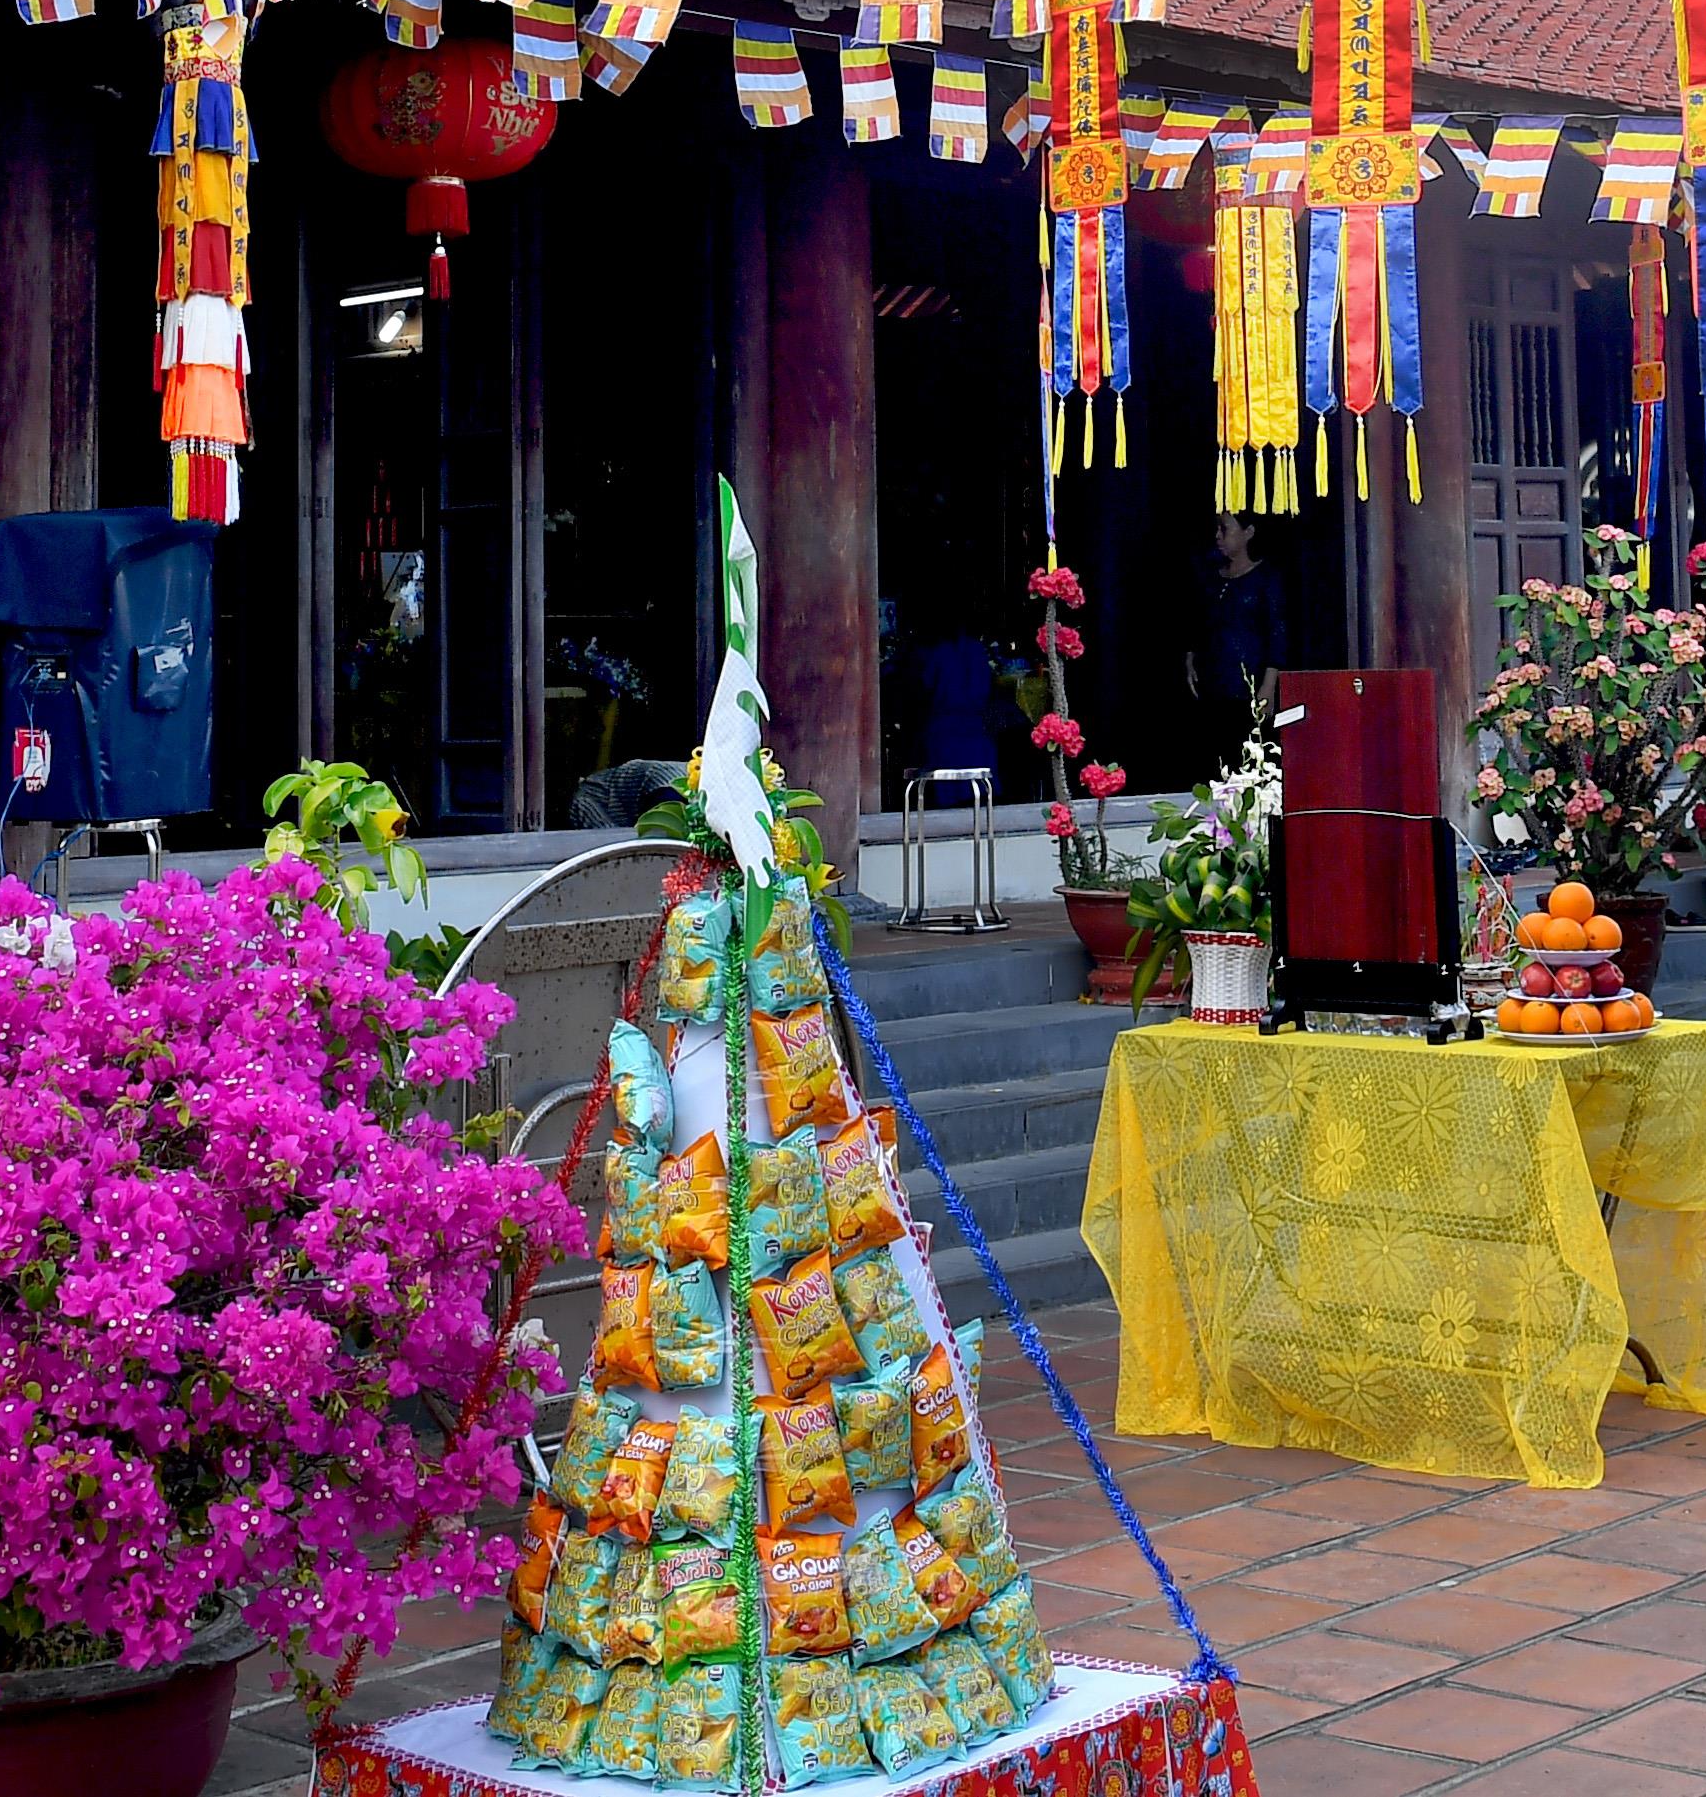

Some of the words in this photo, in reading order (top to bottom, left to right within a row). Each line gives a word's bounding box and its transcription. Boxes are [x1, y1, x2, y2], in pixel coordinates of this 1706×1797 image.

[1352, 961, 1364, 973] 1
[761, 1268, 830, 1327] KORNY
[630, 1431, 672, 1455] QUAY
[771, 1558, 802, 1584] GÀ
